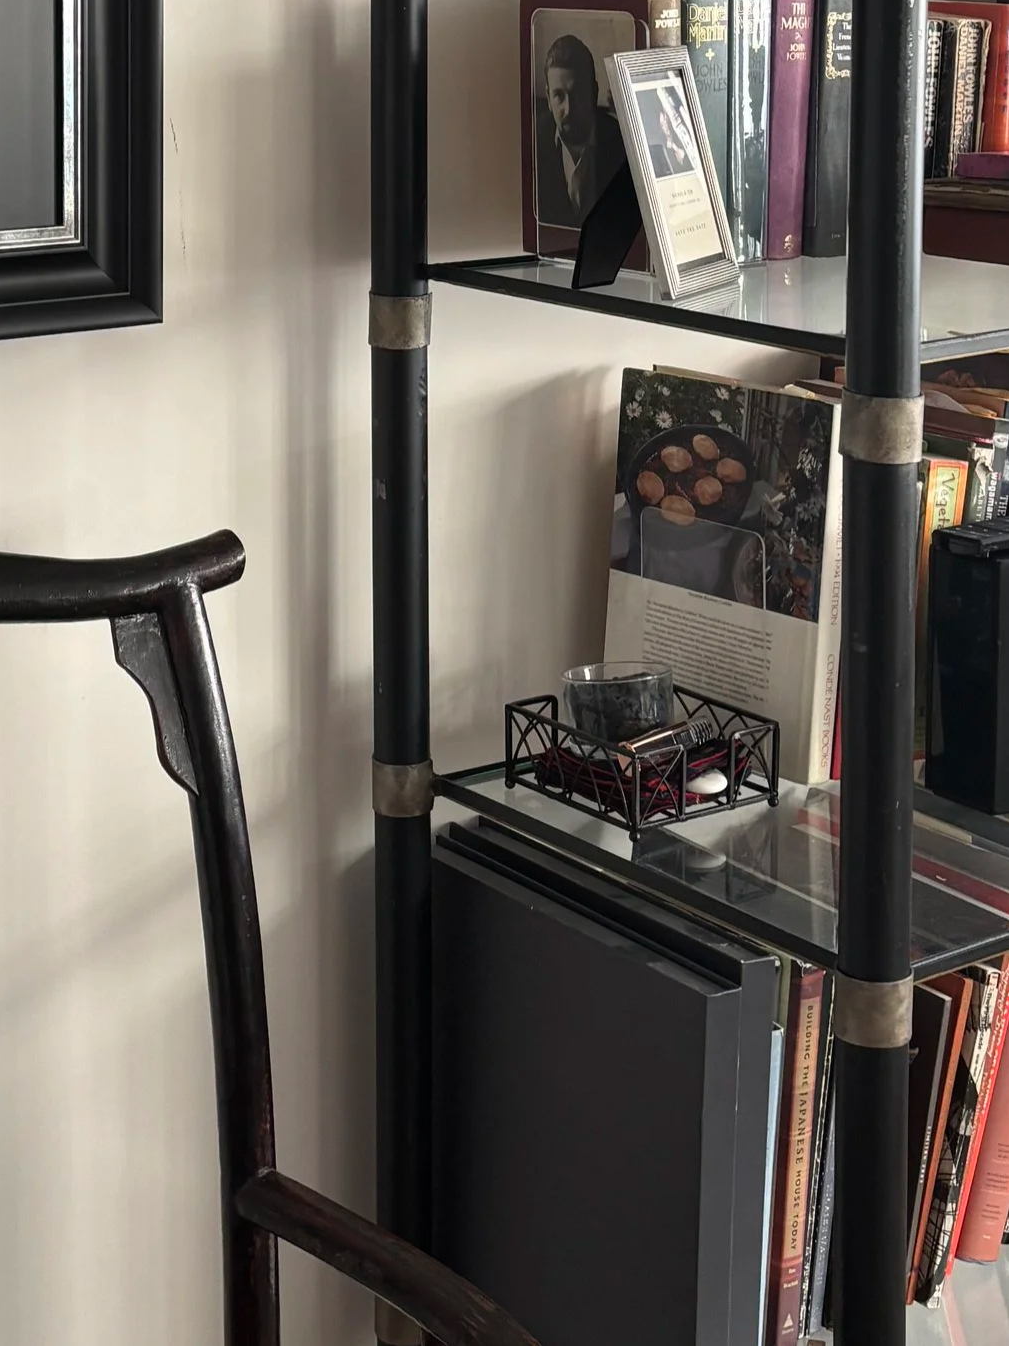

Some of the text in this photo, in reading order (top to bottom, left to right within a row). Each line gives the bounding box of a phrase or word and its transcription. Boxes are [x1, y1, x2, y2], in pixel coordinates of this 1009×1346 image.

[687, 1, 728, 27] Daniel
[695, 62, 724, 78] JOHN
[696, 77, 728, 92] OWLES
[923, 28, 941, 149] JOHN FOWLES
[953, 27, 968, 136] DANIEL MARTIN
[963, 28, 979, 124] JOHN FOWLES
[997, 495, 1009, 517] THE
[830, 581, 841, 626] EDITION
[820, 654, 835, 768] CONDE NAST BOOKS
[789, 1005, 814, 1251] BUILDING THE JAPANESE HOUSE TODAY
